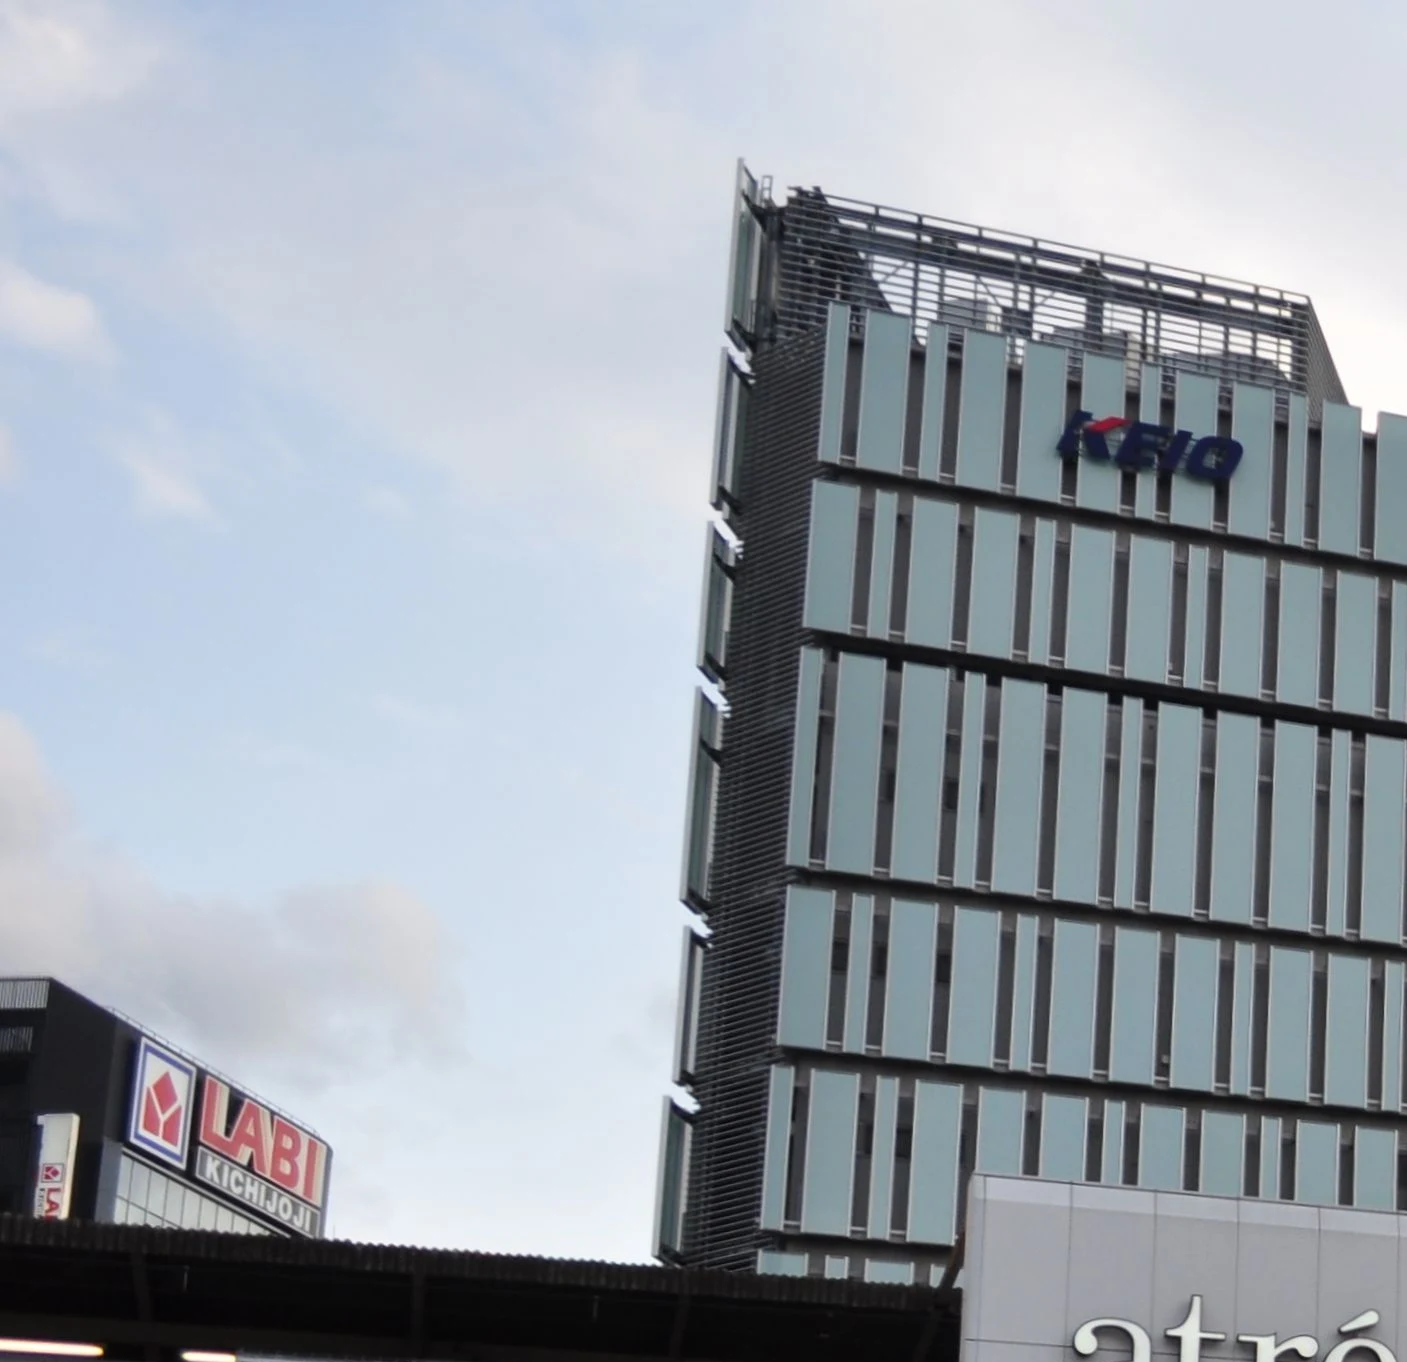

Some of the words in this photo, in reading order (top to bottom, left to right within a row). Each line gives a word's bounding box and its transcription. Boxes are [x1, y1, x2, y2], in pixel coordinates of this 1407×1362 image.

[1056, 409, 1243, 481] KEIO
[200, 1076, 324, 1207] LABI
[205, 1154, 312, 1234] KICHIJOJI
